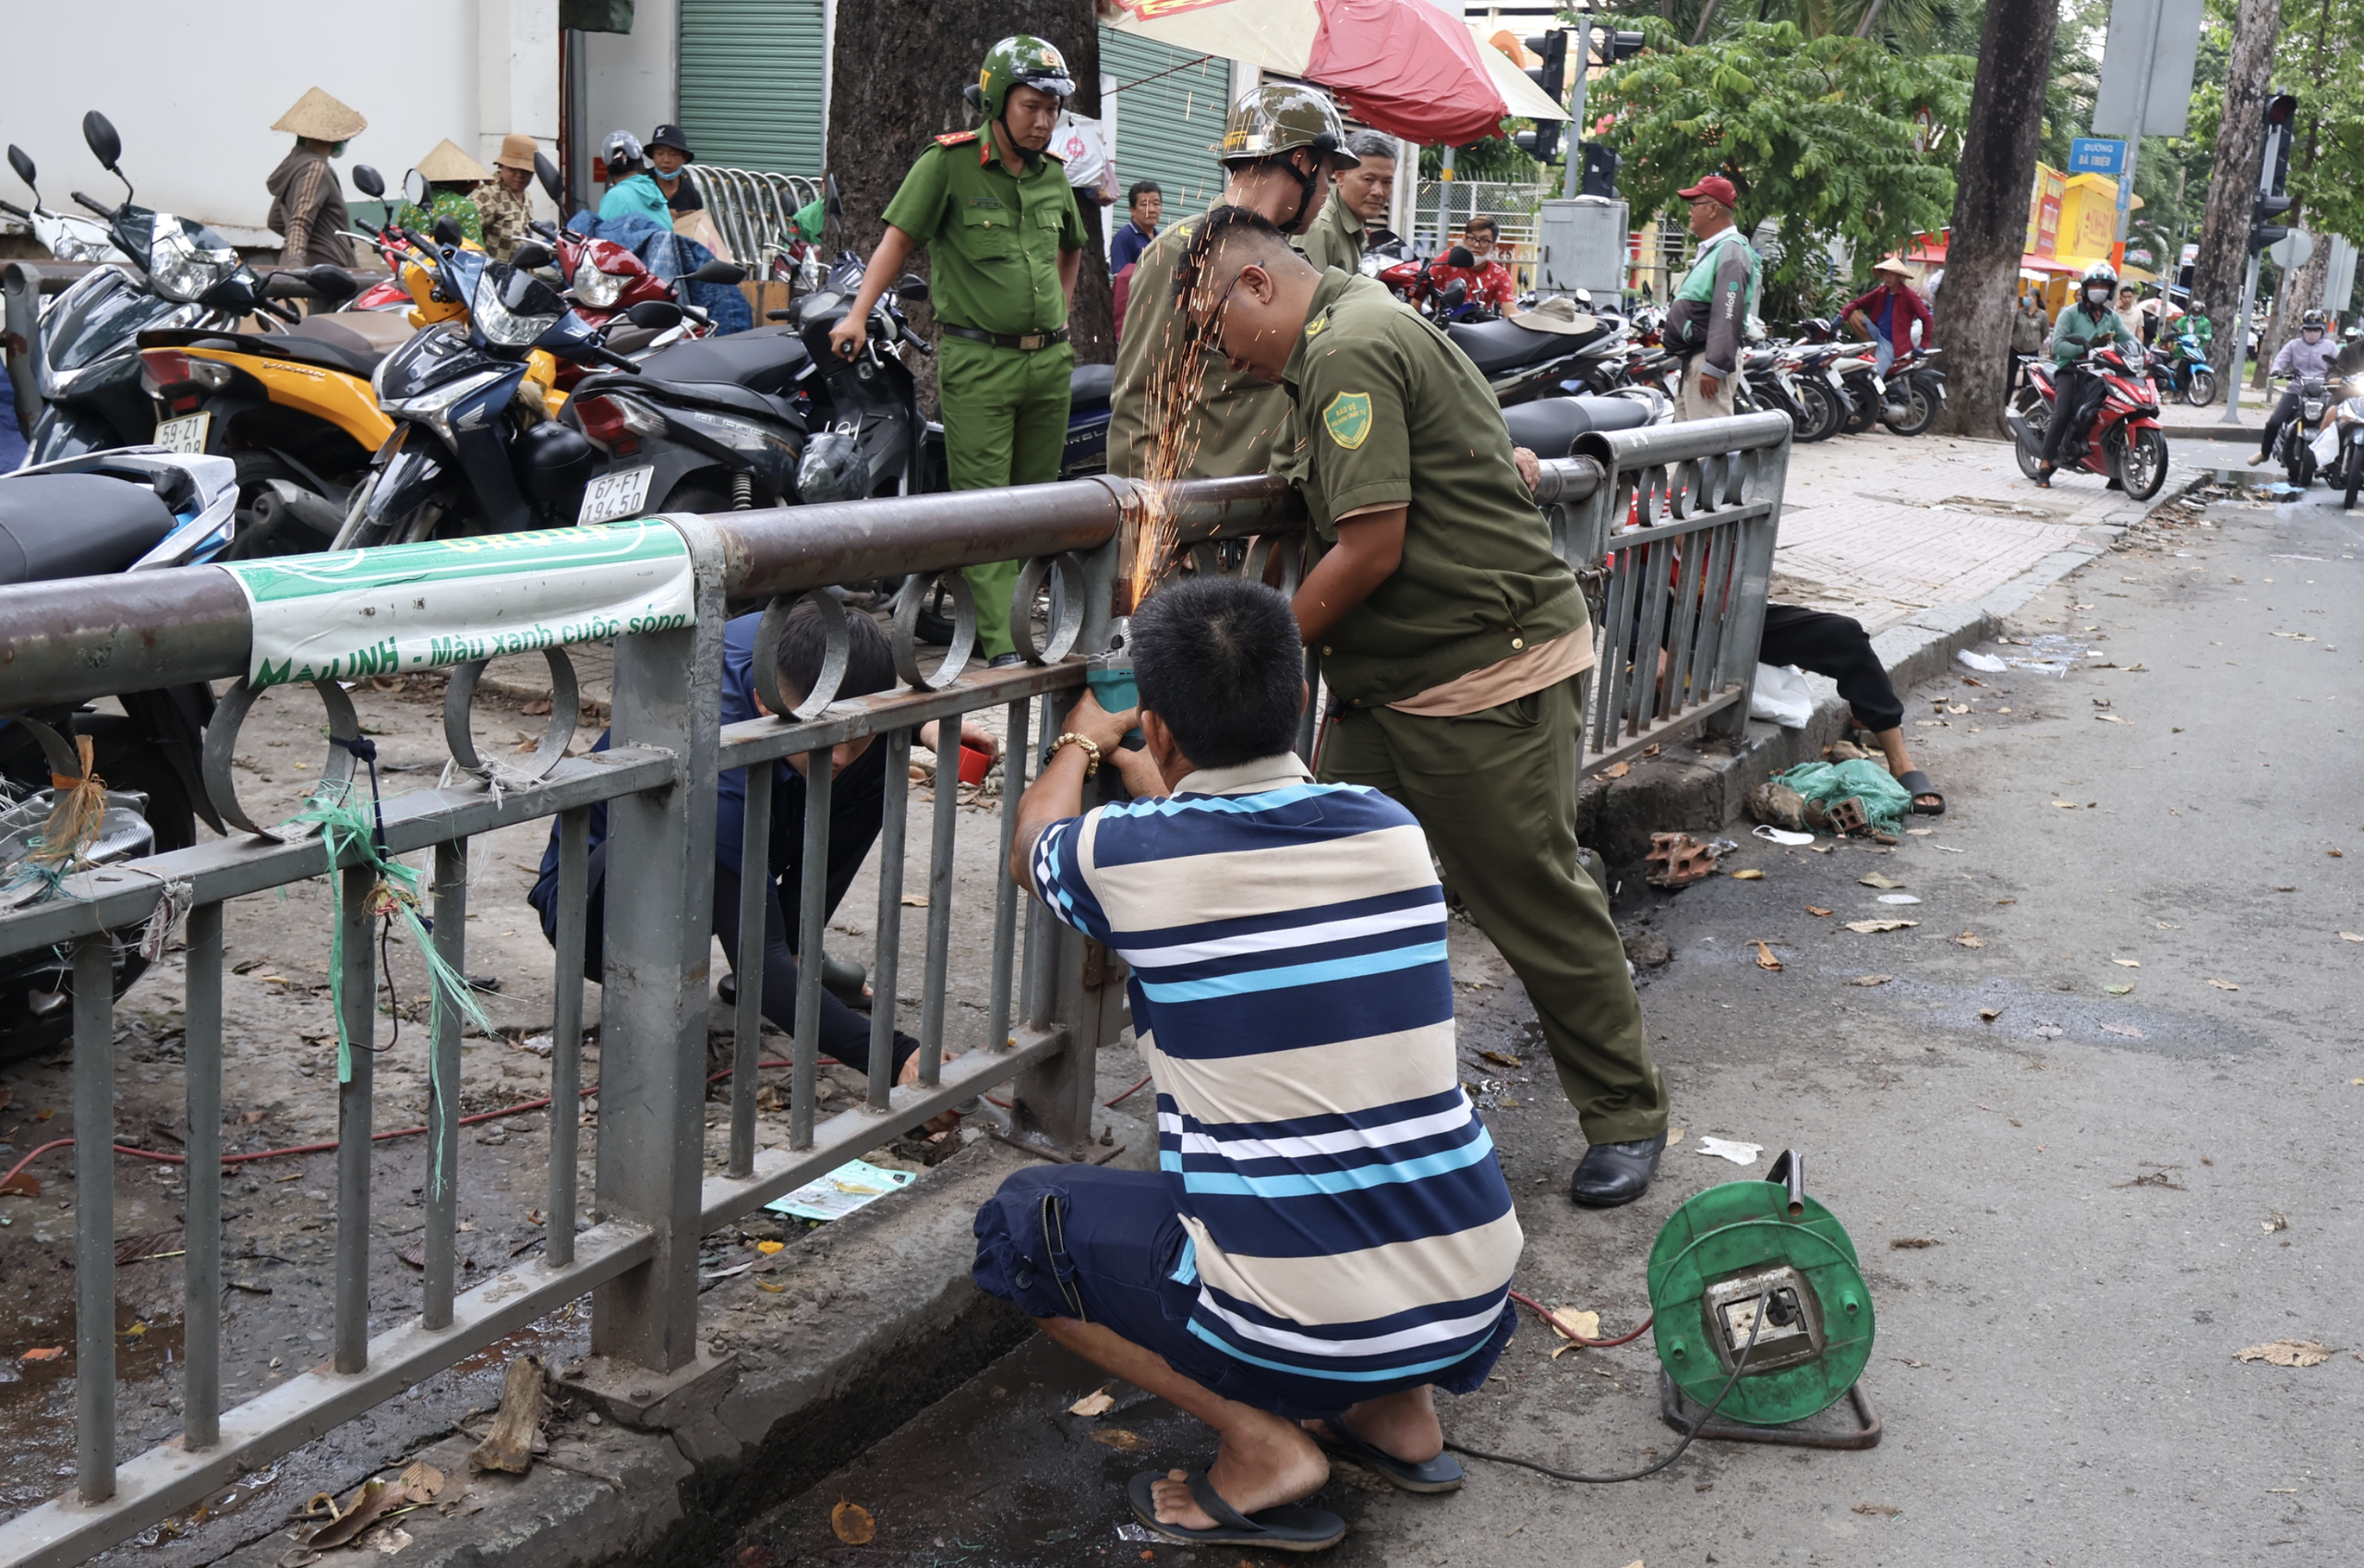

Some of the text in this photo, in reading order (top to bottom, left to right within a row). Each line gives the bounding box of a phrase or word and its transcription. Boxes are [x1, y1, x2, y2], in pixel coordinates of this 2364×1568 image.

[1725, 291, 1736, 320] gojek
[261, 361, 327, 378] VISION
[458, 423, 490, 432] HONDA
[595, 472, 640, 499] 67-F1
[586, 492, 641, 521] 194.50
[429, 634, 485, 667] Màu
[491, 623, 554, 656] xanh
